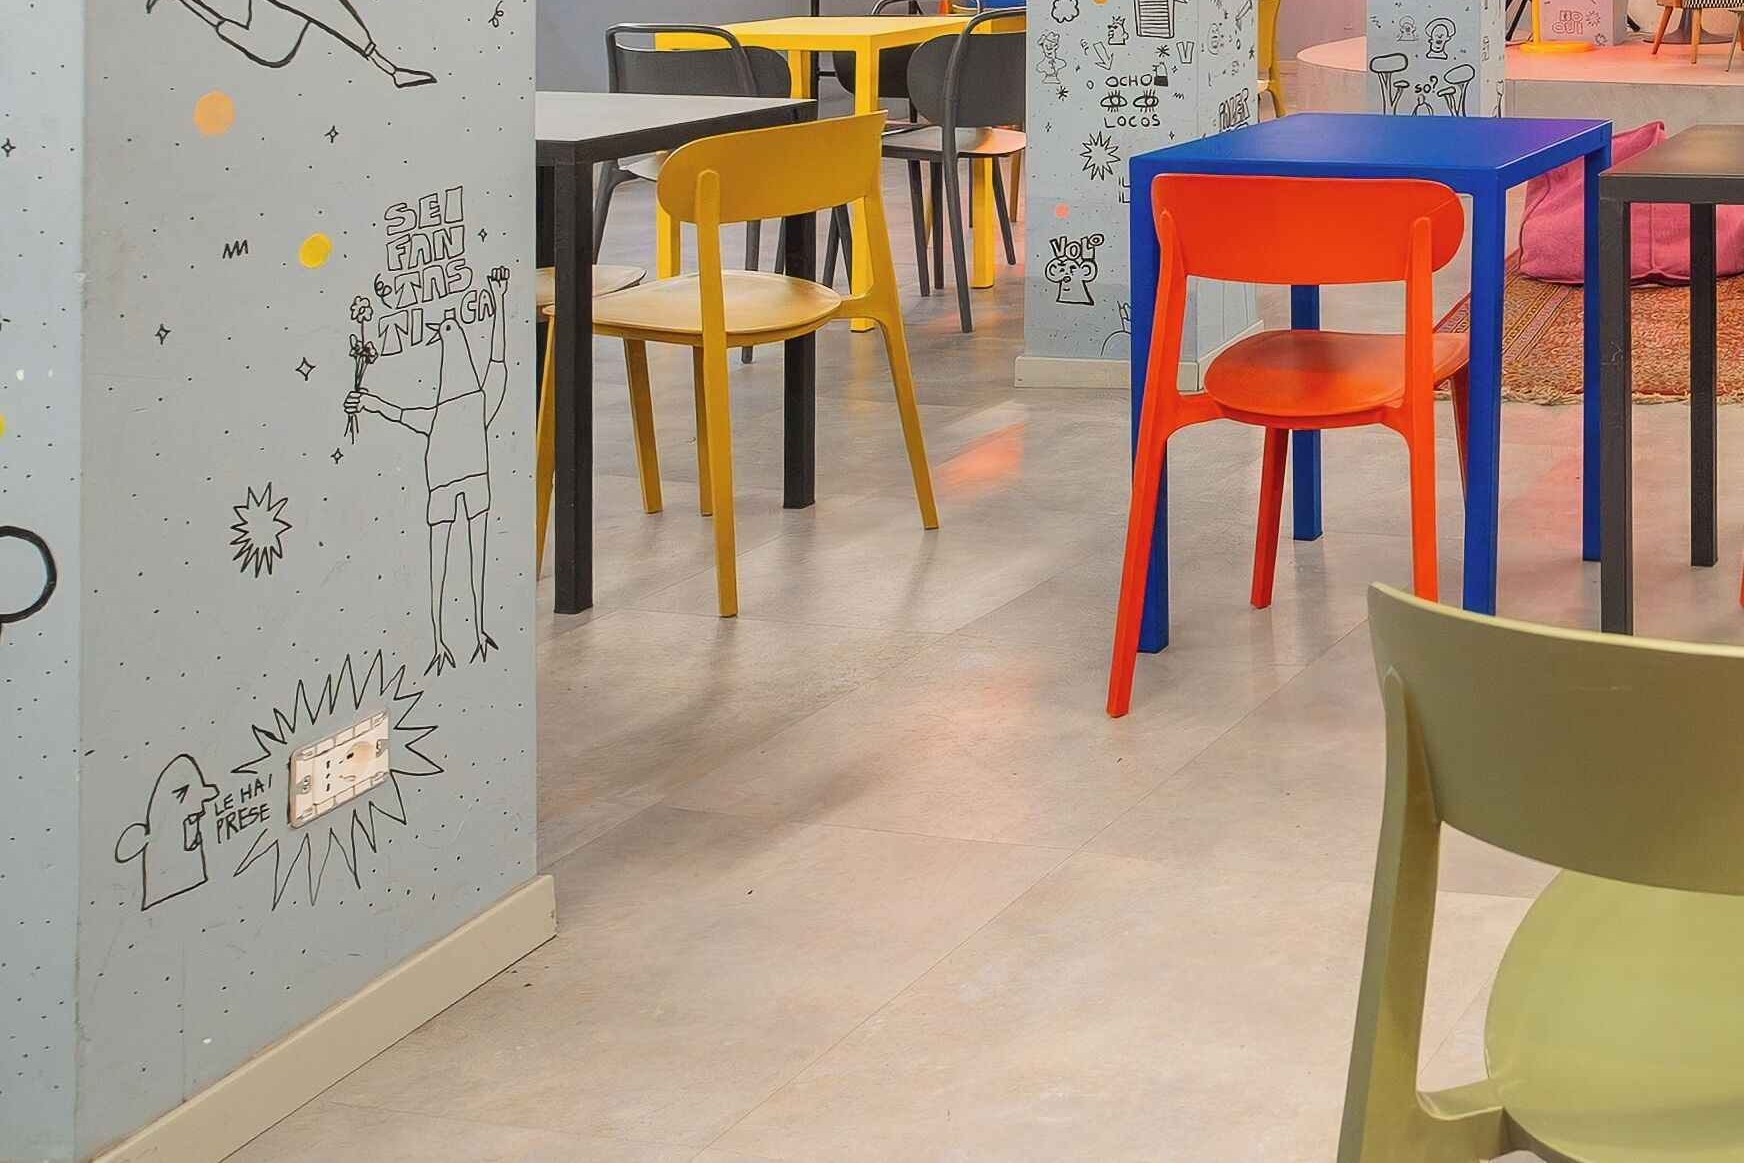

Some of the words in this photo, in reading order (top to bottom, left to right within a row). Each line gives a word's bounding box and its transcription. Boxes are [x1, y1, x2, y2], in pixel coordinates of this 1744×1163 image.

[1105, 74, 1153, 87] OCHO
[1104, 114, 1161, 128] LOCOS
[384, 185, 464, 237] SEI
[386, 224, 466, 272] FAN
[393, 258, 473, 310] TAS
[378, 307, 424, 356] TI
[214, 793, 234, 817] LE
[240, 773, 273, 804] HAI
[215, 803, 271, 845] PRESE
